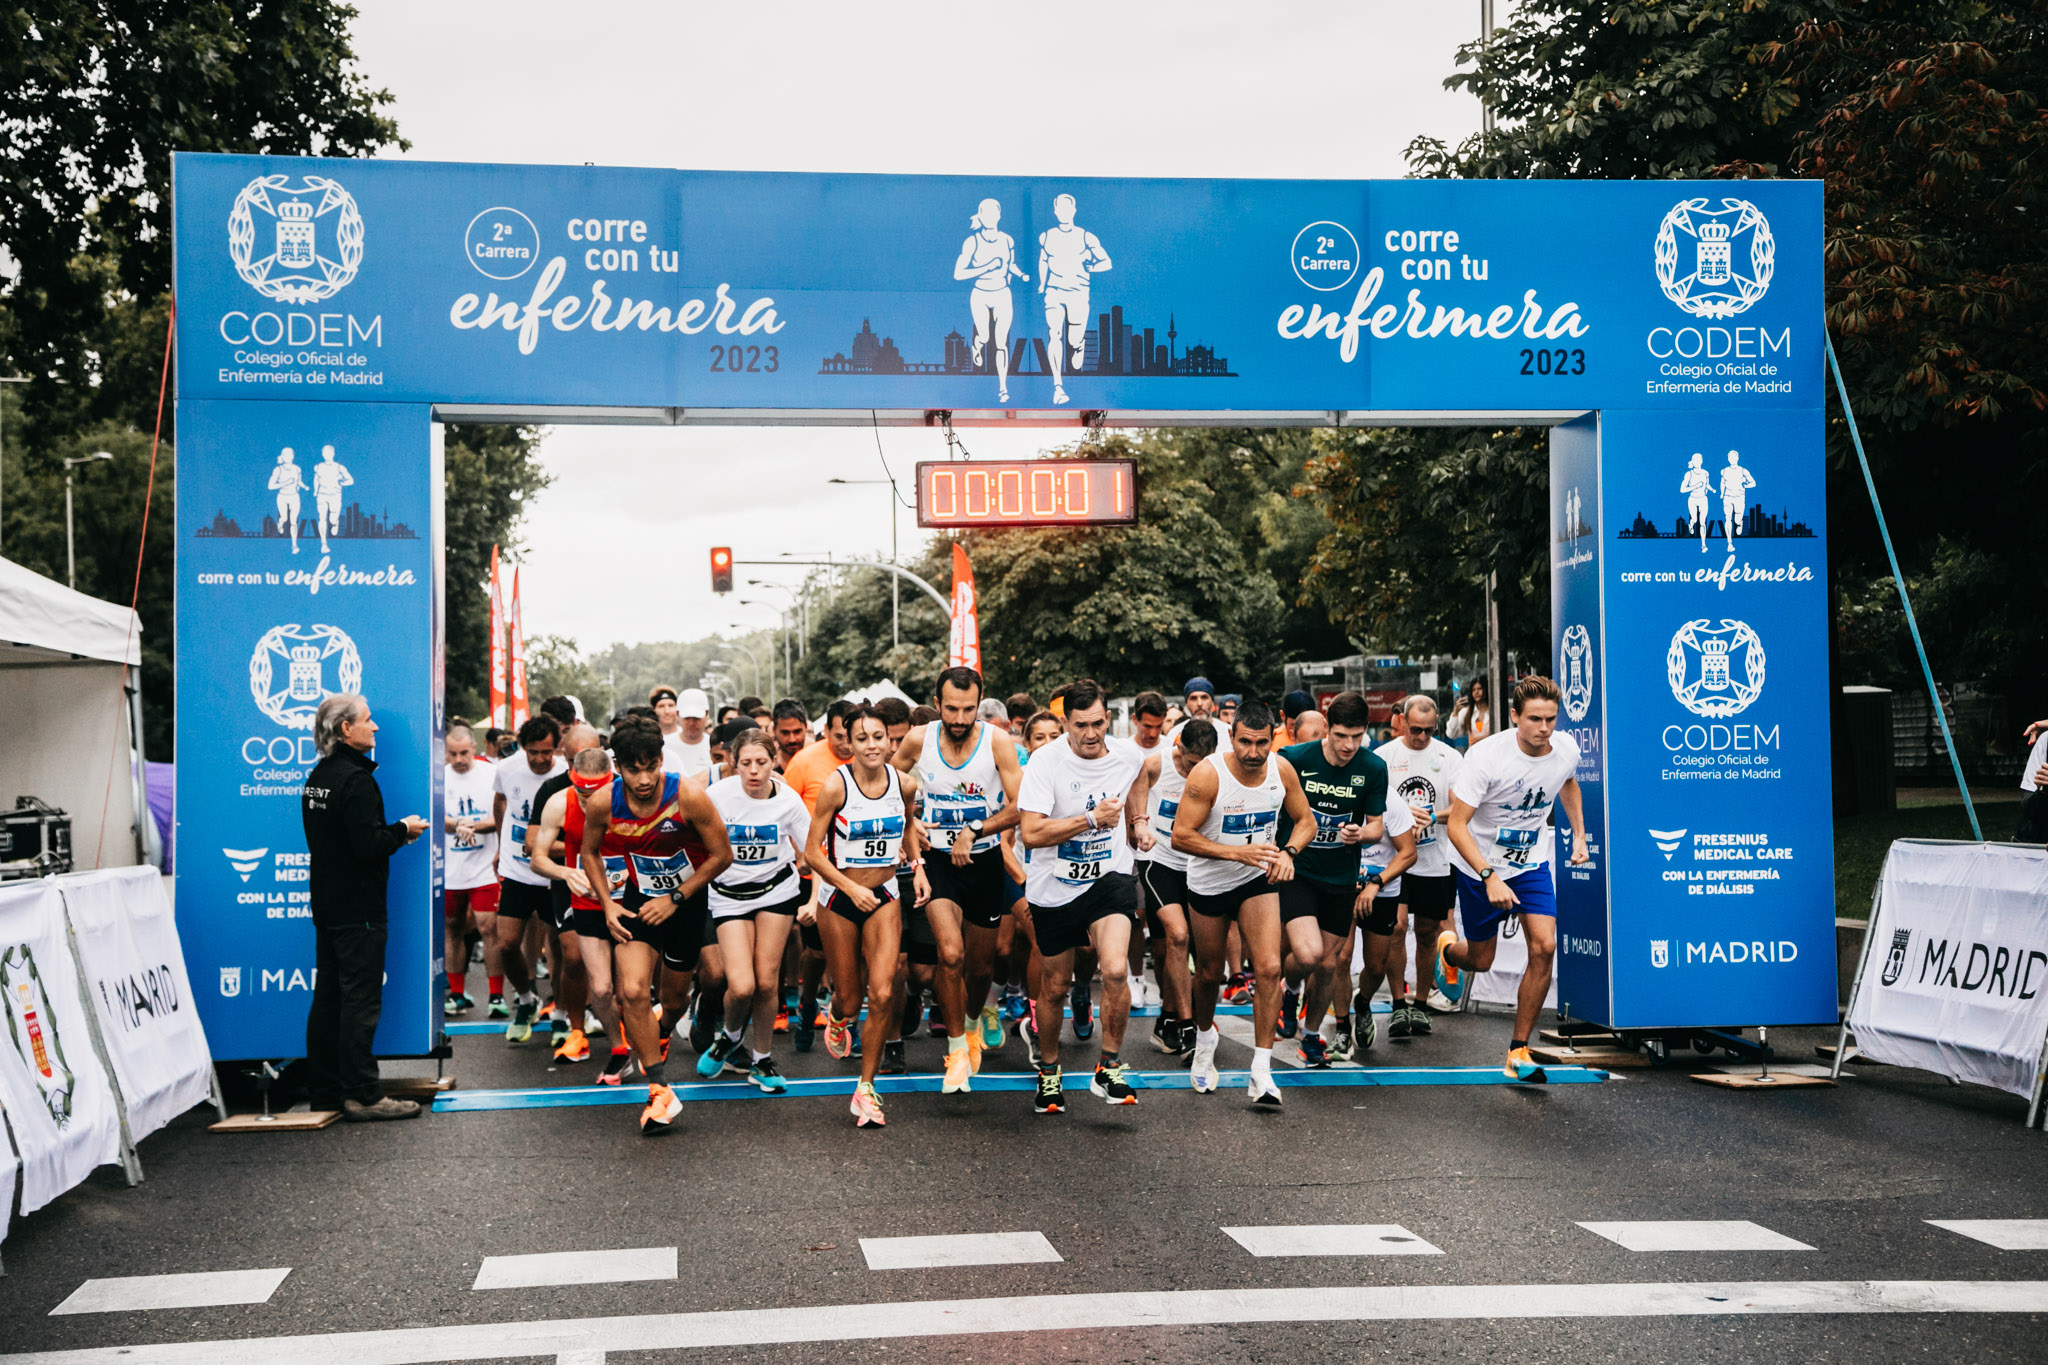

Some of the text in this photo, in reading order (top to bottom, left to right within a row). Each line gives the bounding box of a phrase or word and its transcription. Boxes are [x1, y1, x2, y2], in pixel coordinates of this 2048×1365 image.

[567, 217, 647, 243] corre
[1385, 230, 1460, 253] corre
[475, 243, 530, 260] Carrera
[585, 244, 679, 274] con tu
[1300, 256, 1351, 272] Carrera
[1401, 254, 1489, 281] con tu
[449, 256, 786, 355] enfermera
[1277, 266, 1590, 364] enfermera
[219, 310, 383, 348] CODEM
[1646, 326, 1791, 359] CODEM
[234, 350, 367, 368] Colegio Oficial de
[709, 345, 780, 374] 2023
[1519, 348, 1587, 376] 2023
[306, 370, 327, 385] de
[330, 371, 383, 386] Madrid
[1659, 362, 1777, 380] Colegio Oficial de
[1724, 380, 1742, 395] de
[1745, 380, 1792, 394] Madrid
[197, 555, 417, 595] corre con tu enfermera
[1620, 554, 1814, 591] corre con tu enfermera
[1662, 724, 1780, 751] CODEM
[1672, 754, 1769, 768] Colegio Oficial de
[253, 768, 303, 783] Colegio
[1724, 768, 1740, 780] de
[1742, 768, 1781, 780] Madrid
[1305, 780, 1357, 798] BRASIL
[1316, 831, 1338, 843] 58
[1693, 834, 1768, 846] FRESENIUS
[737, 846, 766, 860] 527
[864, 840, 887, 857] 59
[1502, 848, 1530, 864] 213
[1694, 848, 1793, 861] MEDICAL CARE
[1068, 861, 1101, 880] 324
[1662, 867, 1780, 882] CON LA ENFERMERÍA
[650, 872, 683, 890] 391
[1688, 882, 1755, 895] DE DIÁLISIS
[237, 893, 265, 904] CON
[268, 892, 285, 904] LA
[267, 907, 285, 919] DE
[1572, 936, 1602, 957] MADRID
[1686, 941, 1798, 964] MADRID
[1918, 938, 2048, 1000] MADRID
